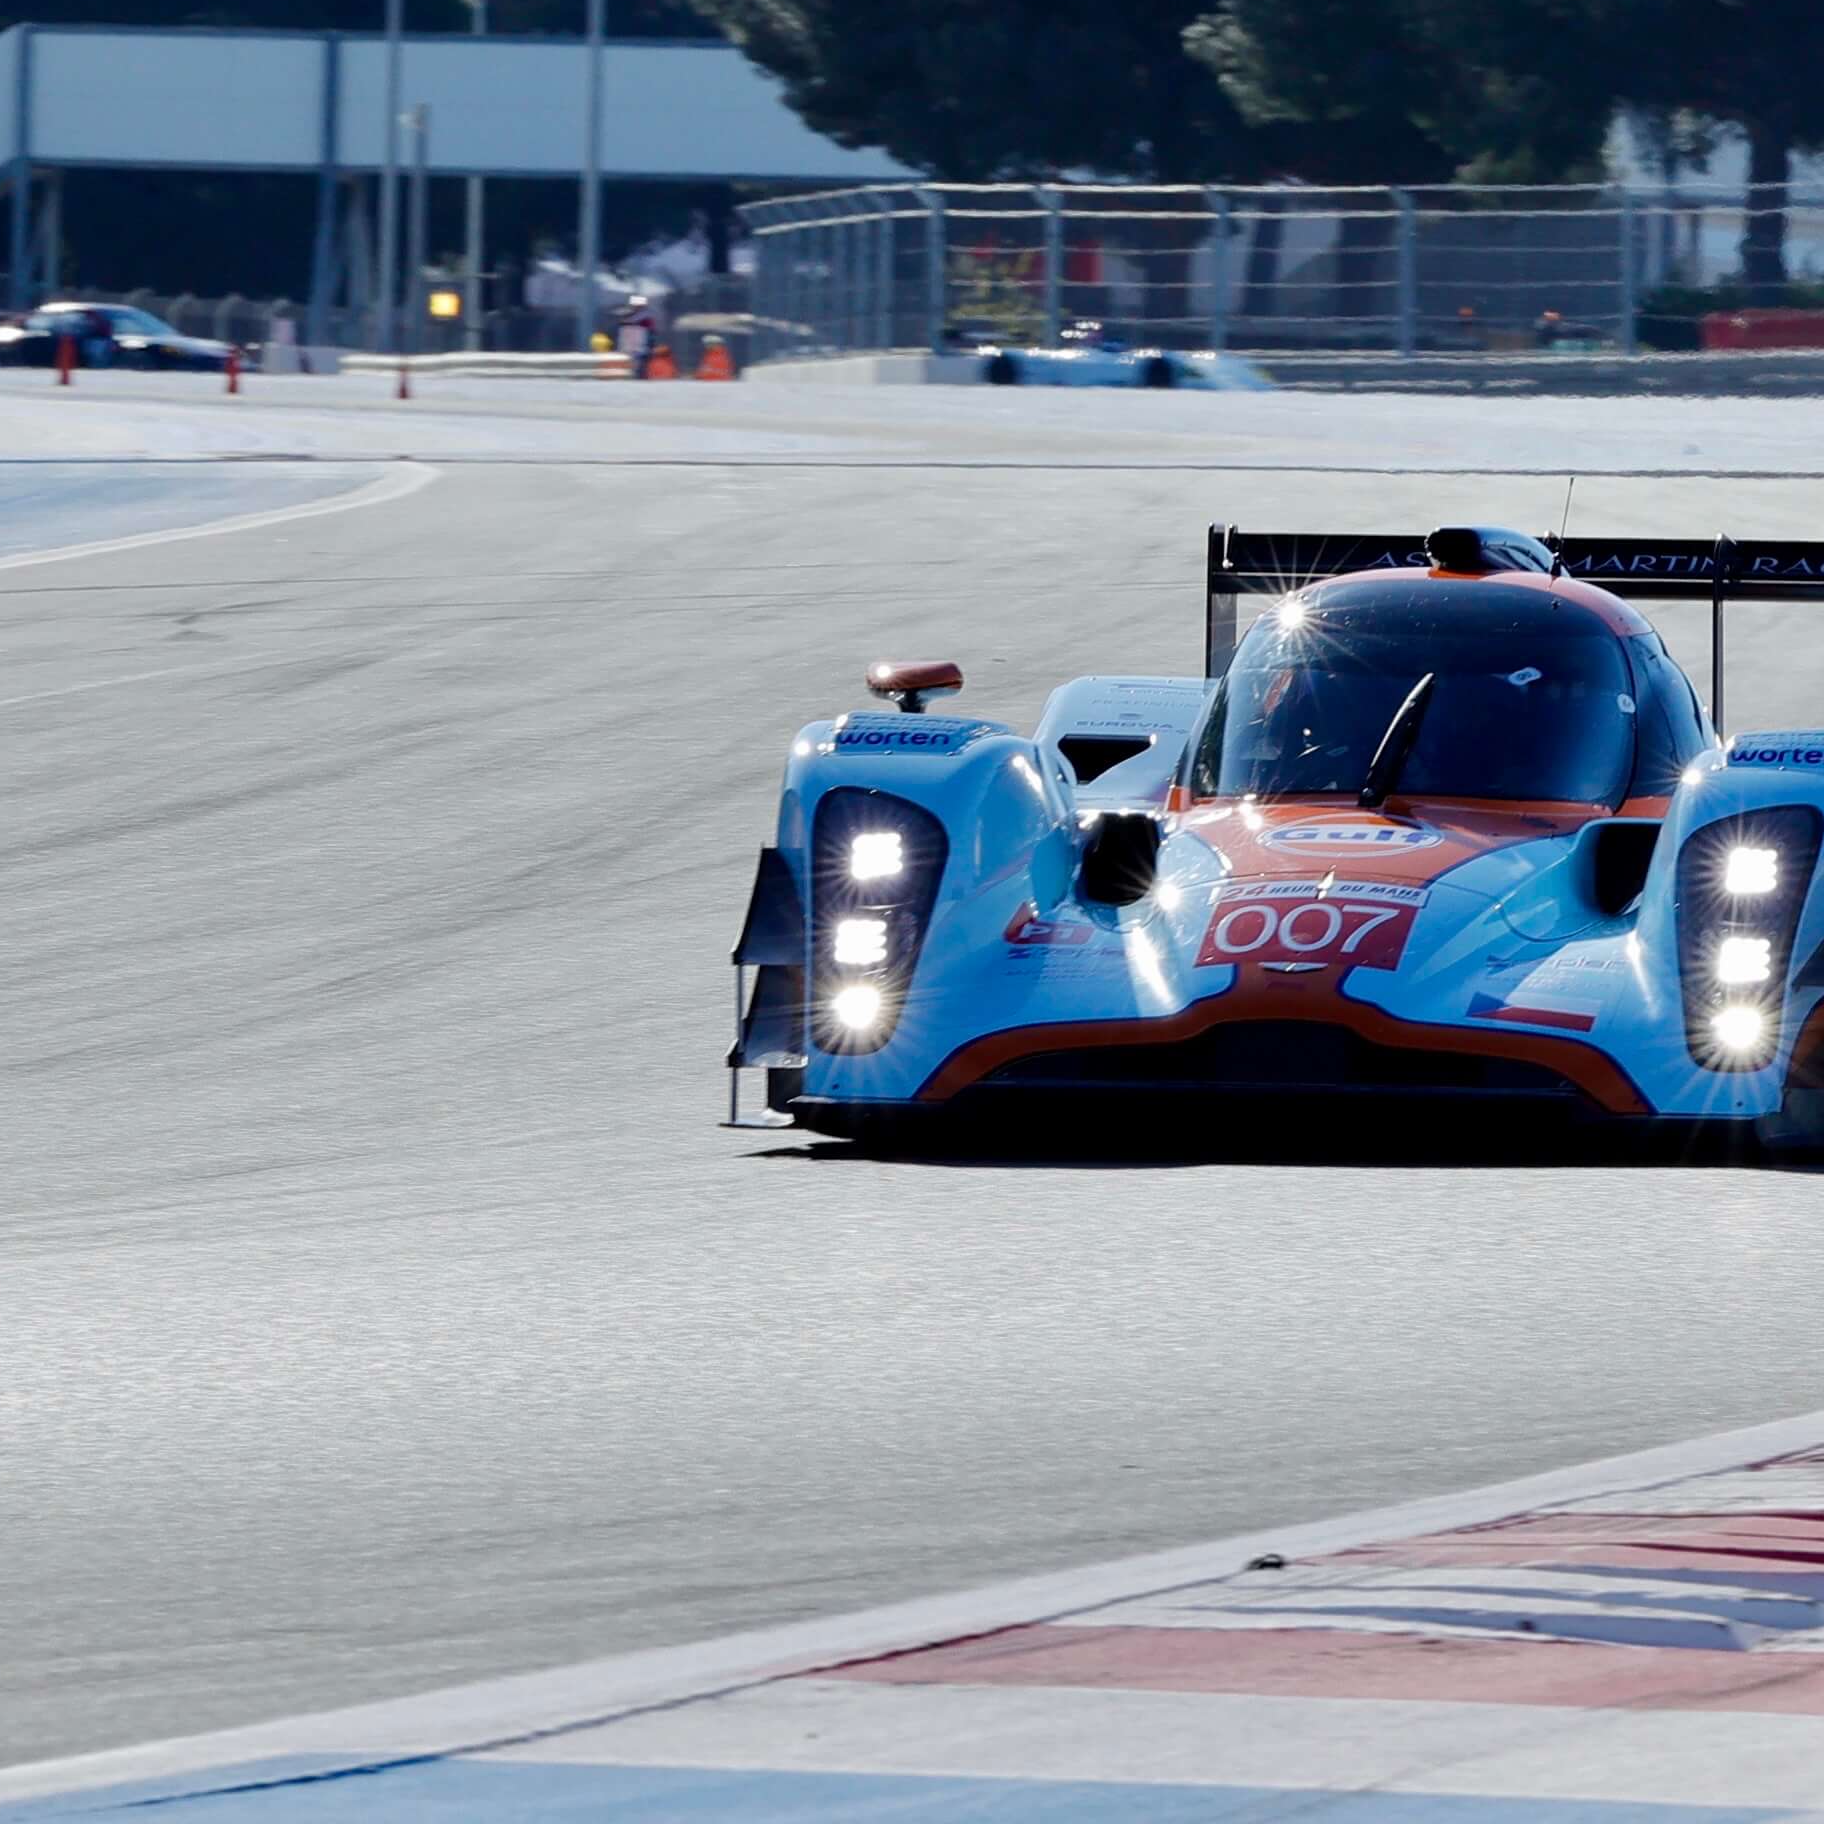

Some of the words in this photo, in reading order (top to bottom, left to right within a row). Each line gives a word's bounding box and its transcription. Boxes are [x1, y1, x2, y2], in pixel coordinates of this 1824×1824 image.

[837, 730, 950, 746] worten
[1272, 828, 1434, 844] Gulf
[1224, 883, 1268, 900] 24
[1269, 884, 1326, 895] HEUR
[1339, 884, 1363, 894] DU
[1368, 885, 1424, 897] MANS
[1214, 903, 1401, 954] 007
